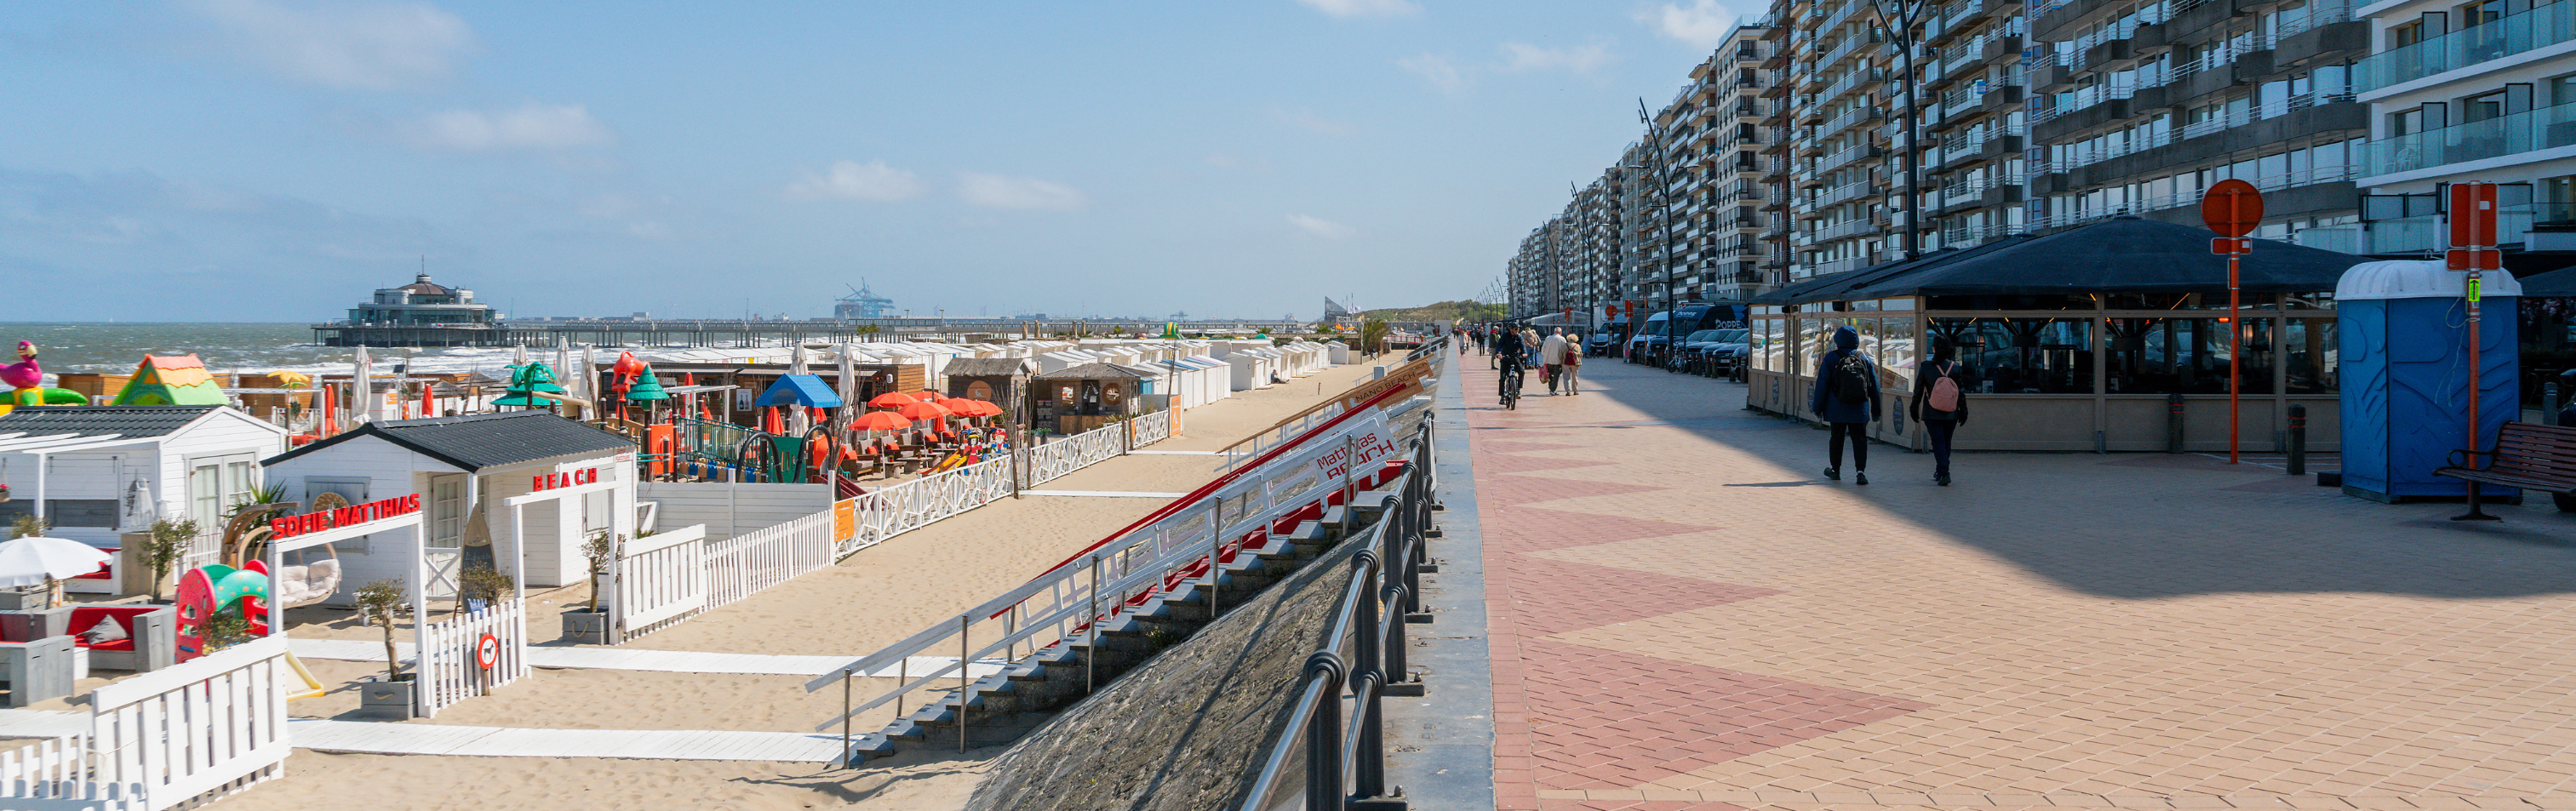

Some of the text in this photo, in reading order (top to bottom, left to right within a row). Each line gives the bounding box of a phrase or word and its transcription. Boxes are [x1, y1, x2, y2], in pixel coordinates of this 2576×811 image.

[1715, 318, 1741, 328] POPPE
[1355, 386, 1383, 402] NANO
[1384, 372, 1416, 390] BEACH
[1316, 432, 1377, 470] Mattas
[533, 467, 598, 493] BEACH
[271, 493, 421, 540] SOFIE MATTHIAS
